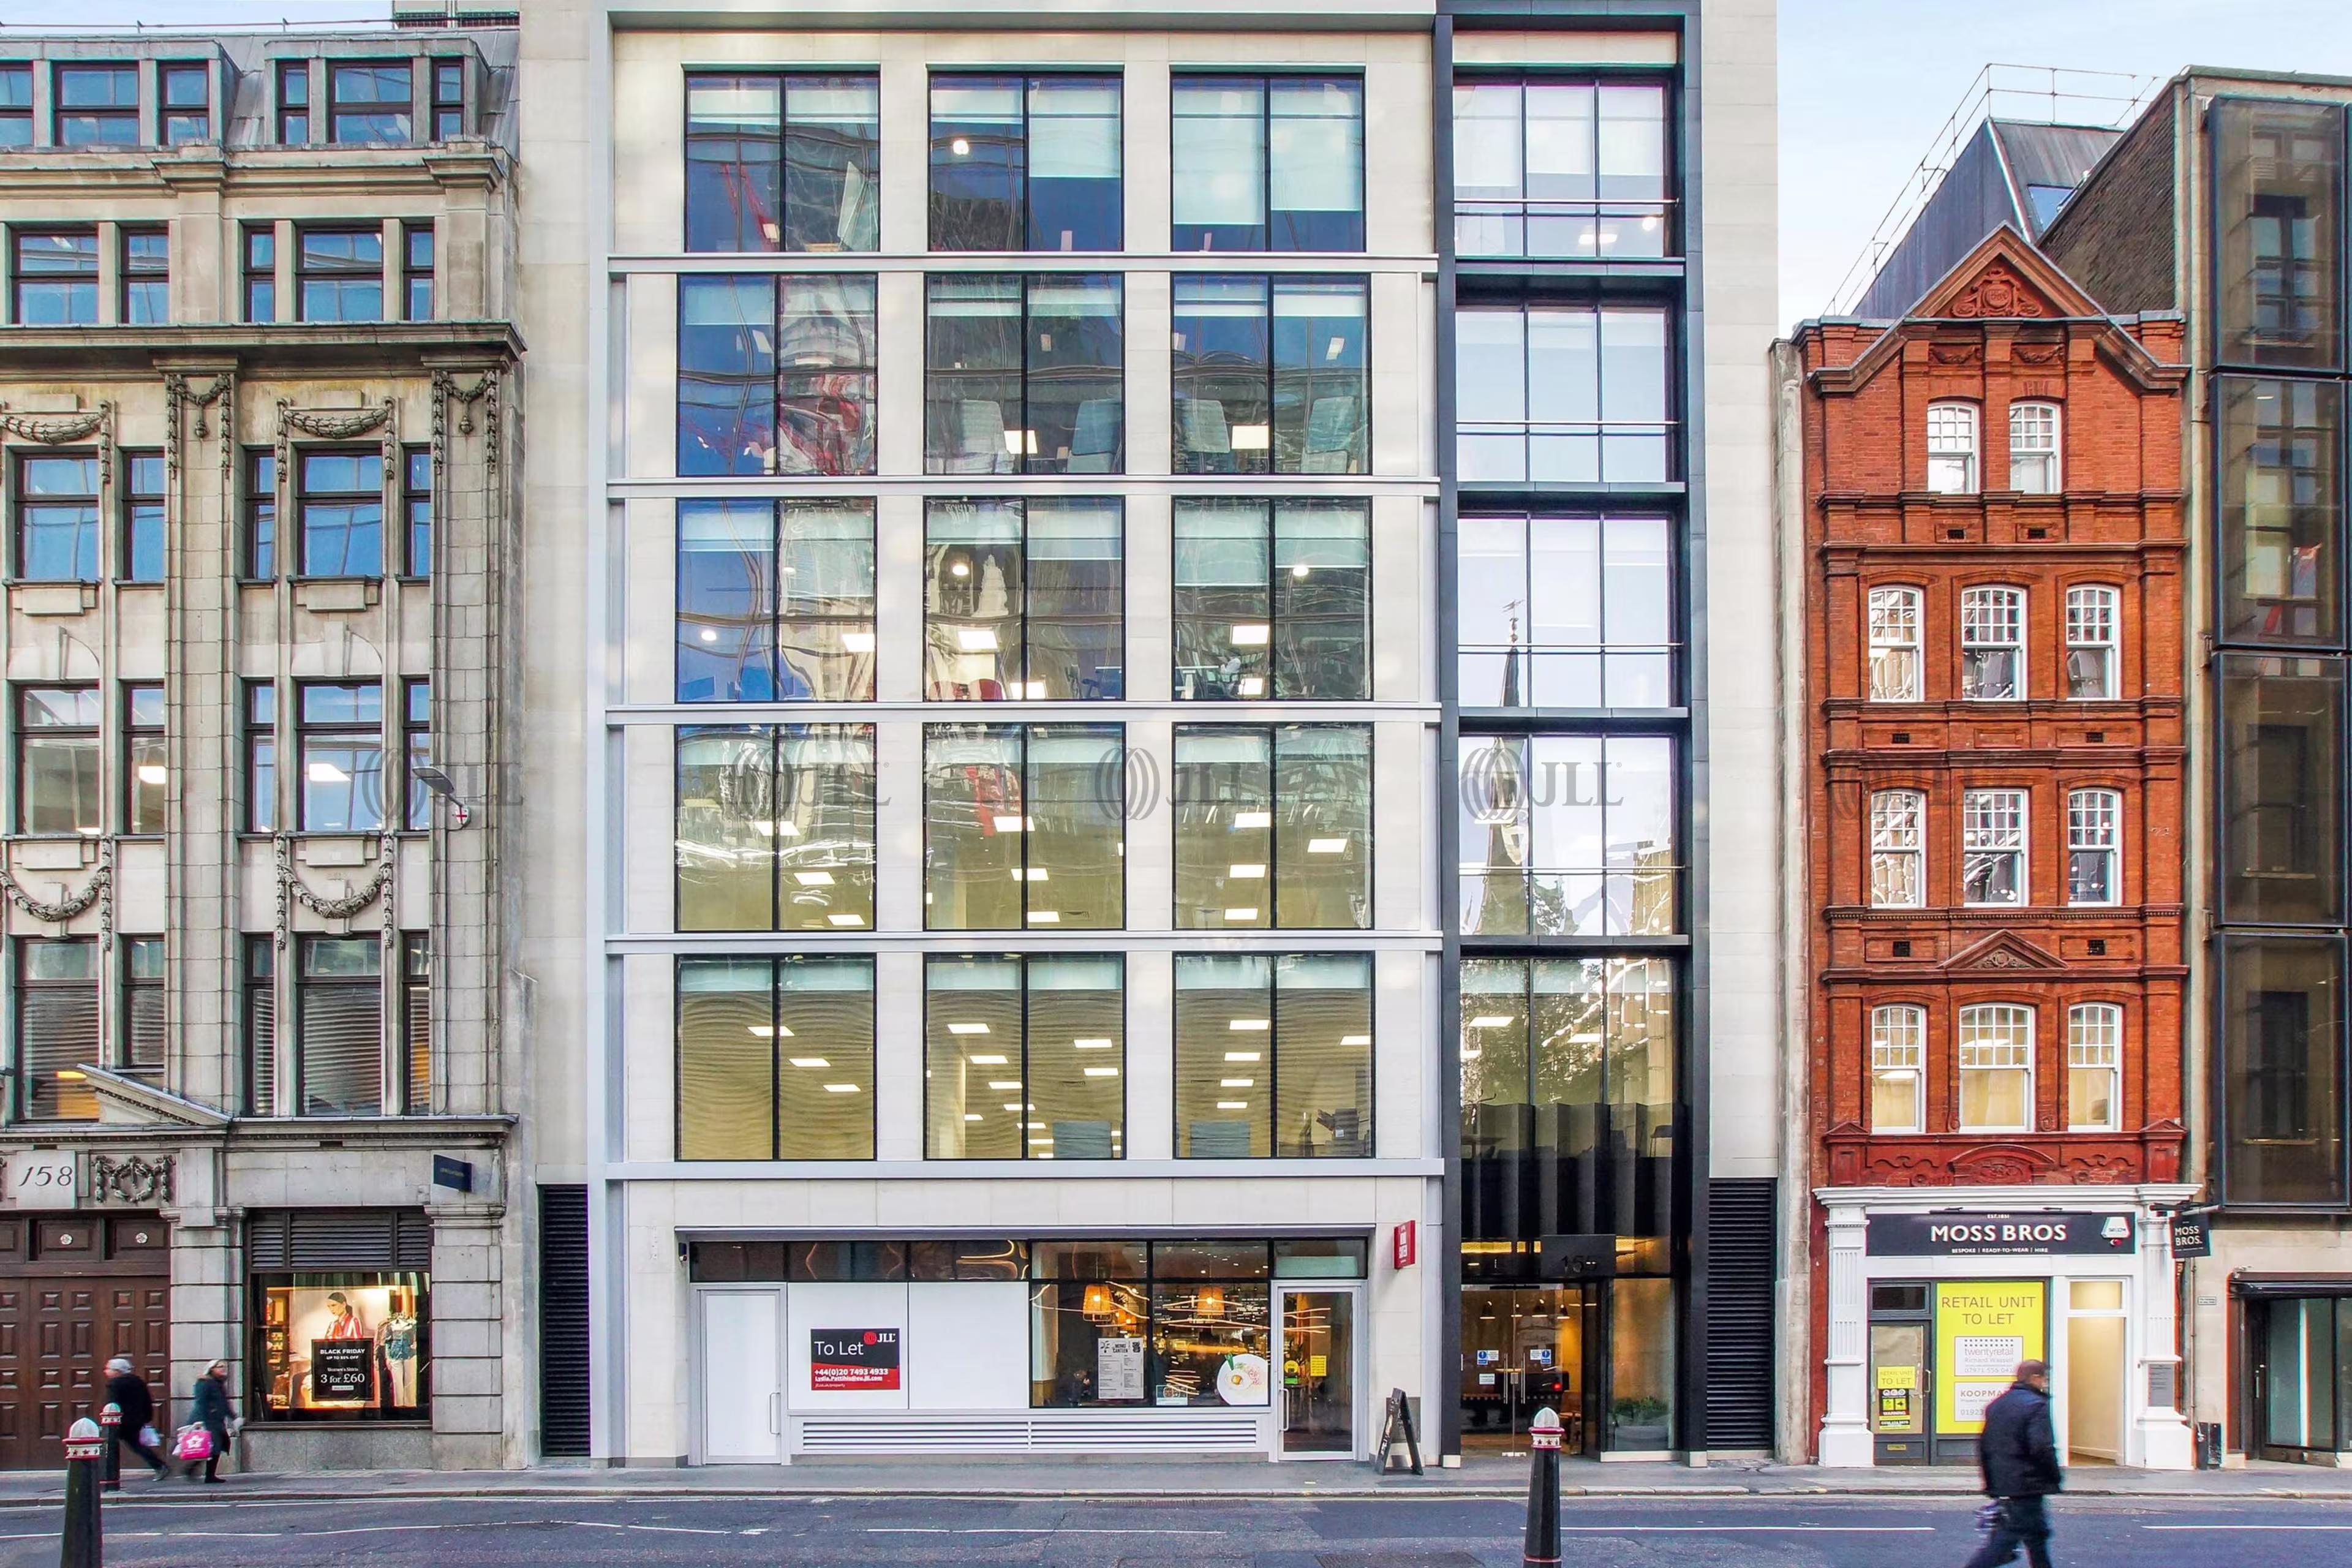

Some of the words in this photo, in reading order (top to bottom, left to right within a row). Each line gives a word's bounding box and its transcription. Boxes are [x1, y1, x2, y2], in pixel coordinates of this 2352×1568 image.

[18, 1166, 73, 1187] 158
[1930, 1224, 1997, 1242] MOSS
[2002, 1224, 2067, 1242] BROS
[2175, 1226, 2199, 1235] MOSS
[1941, 1297, 1994, 1308] RETAIL
[1999, 1297, 2036, 1308] UNIT
[1962, 1313, 1983, 1325] TO
[1989, 1313, 2015, 1325] LET
[814, 1341, 834, 1355] To
[839, 1341, 864, 1355] Let
[814, 1368, 848, 1376] +44(0)20
[320, 1374, 328, 1383] 3
[344, 1373, 365, 1382] £60
